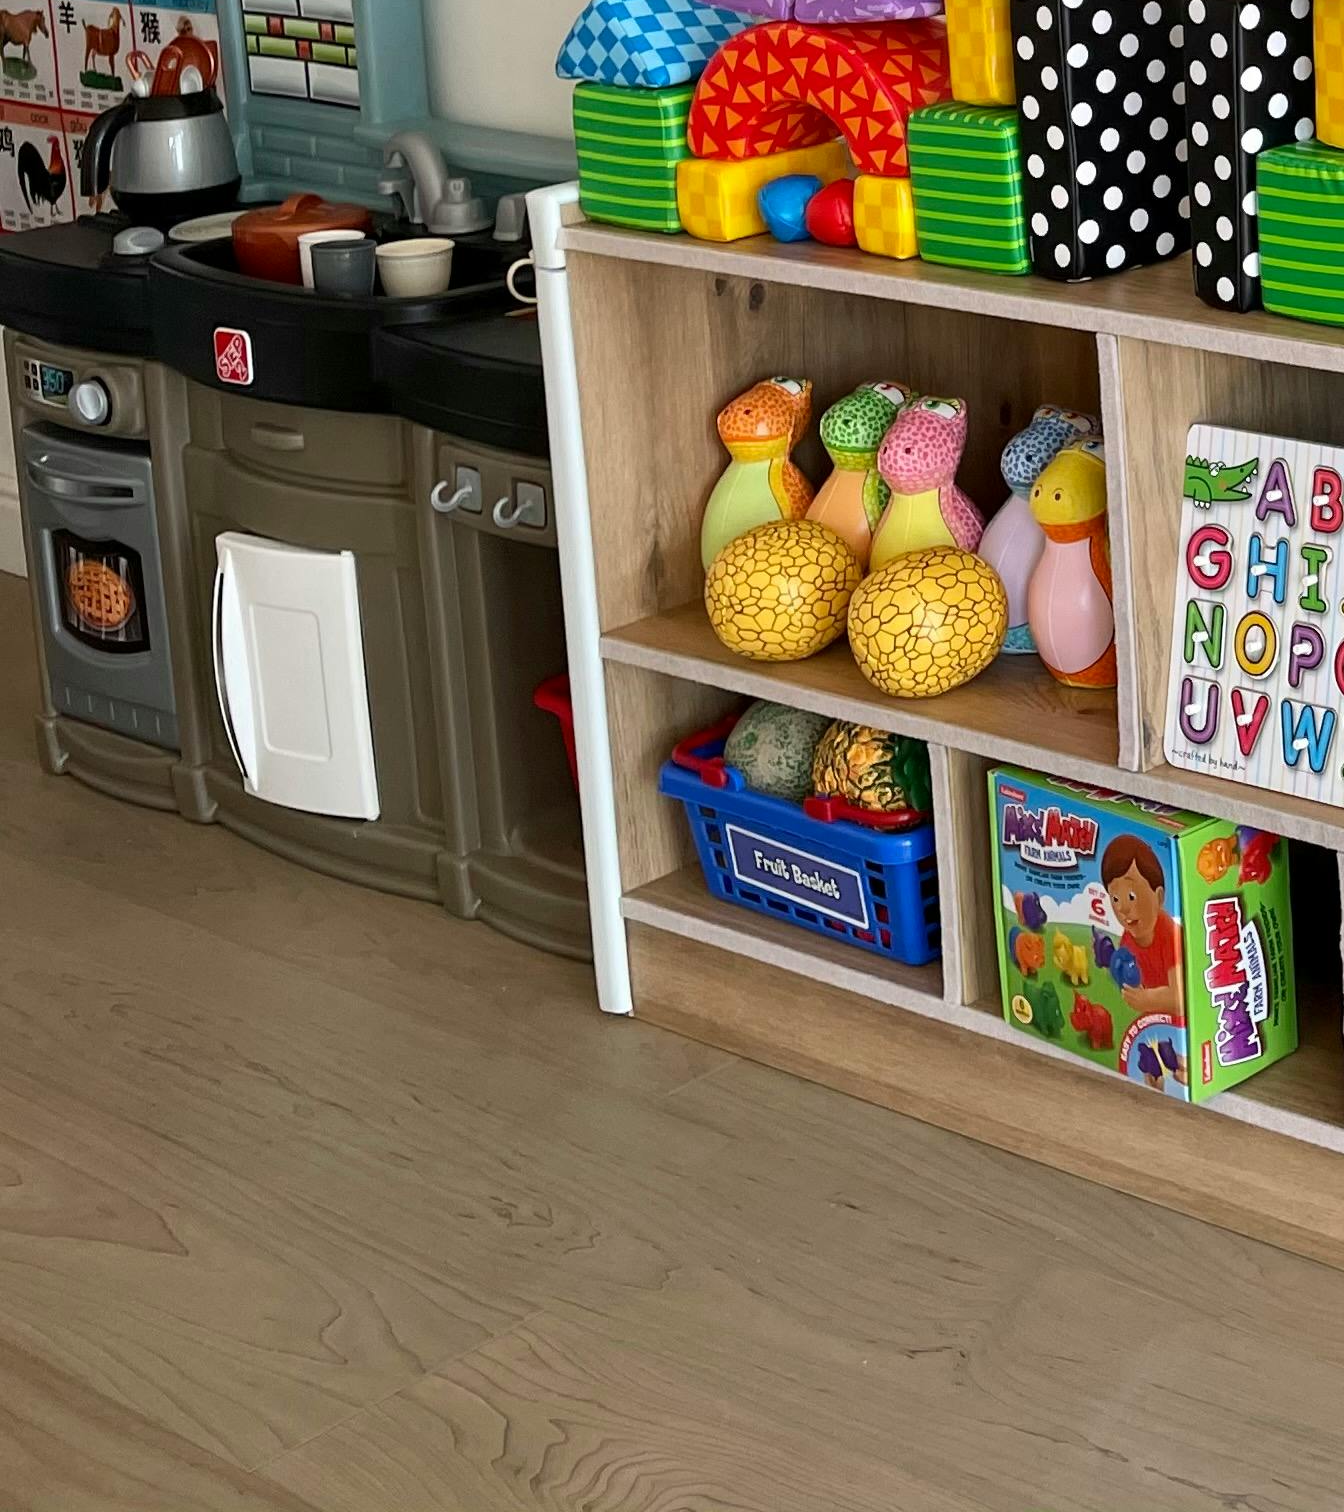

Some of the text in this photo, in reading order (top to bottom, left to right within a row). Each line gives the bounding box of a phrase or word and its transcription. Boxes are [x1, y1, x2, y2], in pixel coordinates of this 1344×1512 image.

[58, 0, 78, 34] 羊
[140, 12, 162, 45] 猴
[1255, 461, 1296, 527] A
[1310, 468, 1344, 533] B
[1186, 526, 1233, 590] G
[1246, 535, 1289, 604] H
[1299, 546, 1328, 613] I
[1184, 600, 1224, 668] N
[1234, 611, 1277, 676] O
[1287, 624, 1324, 688] P
[1179, 678, 1220, 744] U
[1231, 689, 1269, 756] V
[1281, 699, 1335, 773] W
[1208, 753, 1219, 769] by
[753, 849, 841, 900] Fruit Basket
[1044, 847, 1072, 863] ANIMALS
[1090, 898, 1106, 917] 6
[1243, 931, 1264, 1016] FARM ANIMALS
[1120, 1014, 1173, 1062] EASY TO CONNECT!
